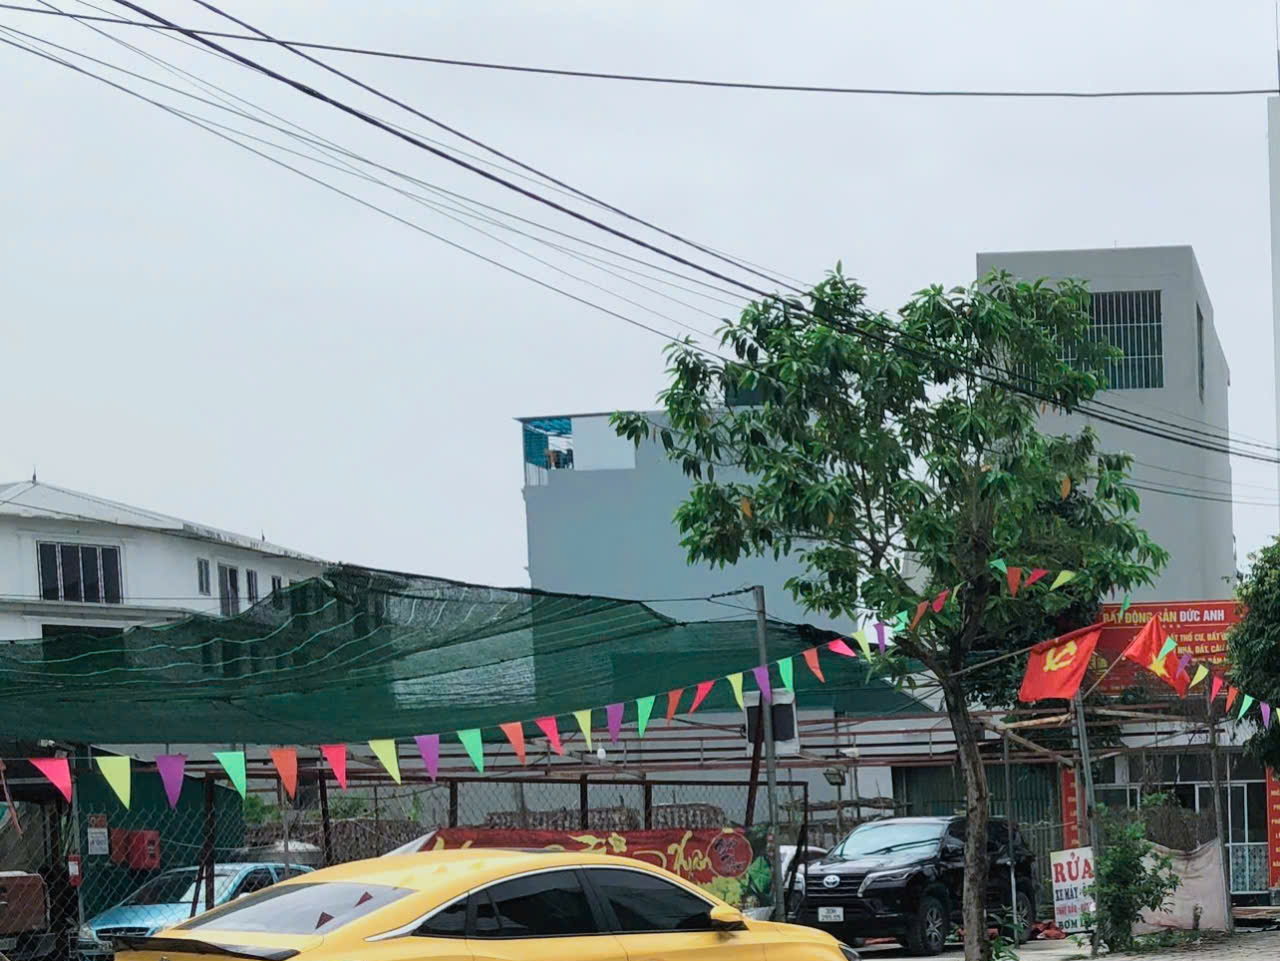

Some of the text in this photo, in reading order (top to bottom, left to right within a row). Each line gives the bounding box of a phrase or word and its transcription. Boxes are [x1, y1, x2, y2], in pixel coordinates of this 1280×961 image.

[1179, 609, 1200, 622] ĐỨC
[1203, 609, 1225, 621] ANH
[1053, 851, 1095, 883] RỬA
